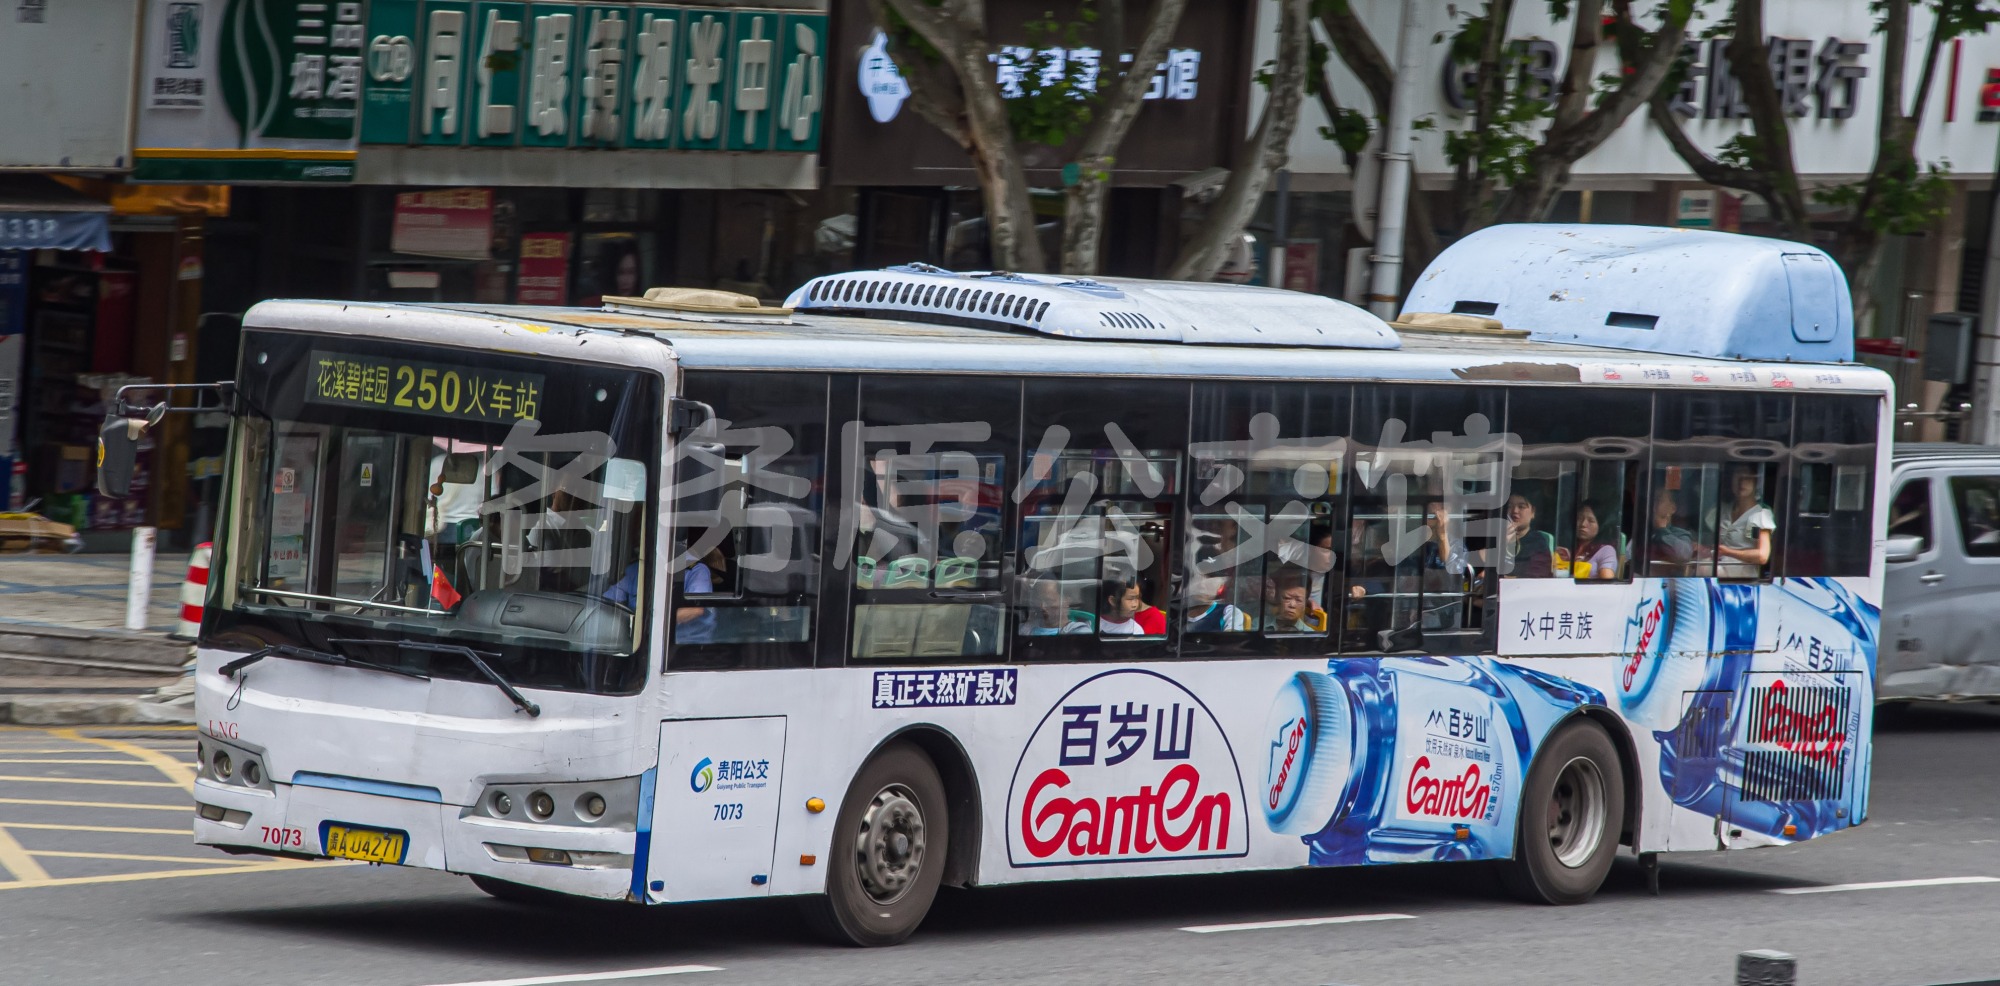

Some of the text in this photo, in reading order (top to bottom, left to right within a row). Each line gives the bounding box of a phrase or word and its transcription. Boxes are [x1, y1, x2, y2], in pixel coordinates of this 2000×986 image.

[293, 2, 364, 48] 三品
[289, 53, 362, 99] 烟酒
[423, 9, 821, 145] 同仁眼镜视光中心
[317, 358, 538, 420] 花溪碧桂园 250 火车站
[1519, 611, 1594, 641] 水中贵族
[1808, 636, 1845, 685] 百岁山
[875, 671, 1015, 707] 真正天然矿泉水
[209, 720, 239, 740] LNG
[1059, 701, 1195, 767] 百岁山
[1449, 707, 1487, 743] 百岁山
[717, 759, 769, 781] 贵阳公交
[1269, 717, 1307, 810] Ganten
[1021, 764, 1231, 858] Ganten
[1407, 756, 1490, 820] Ganten
[714, 803, 743, 821] 7073
[261, 826, 302, 846] 7073
